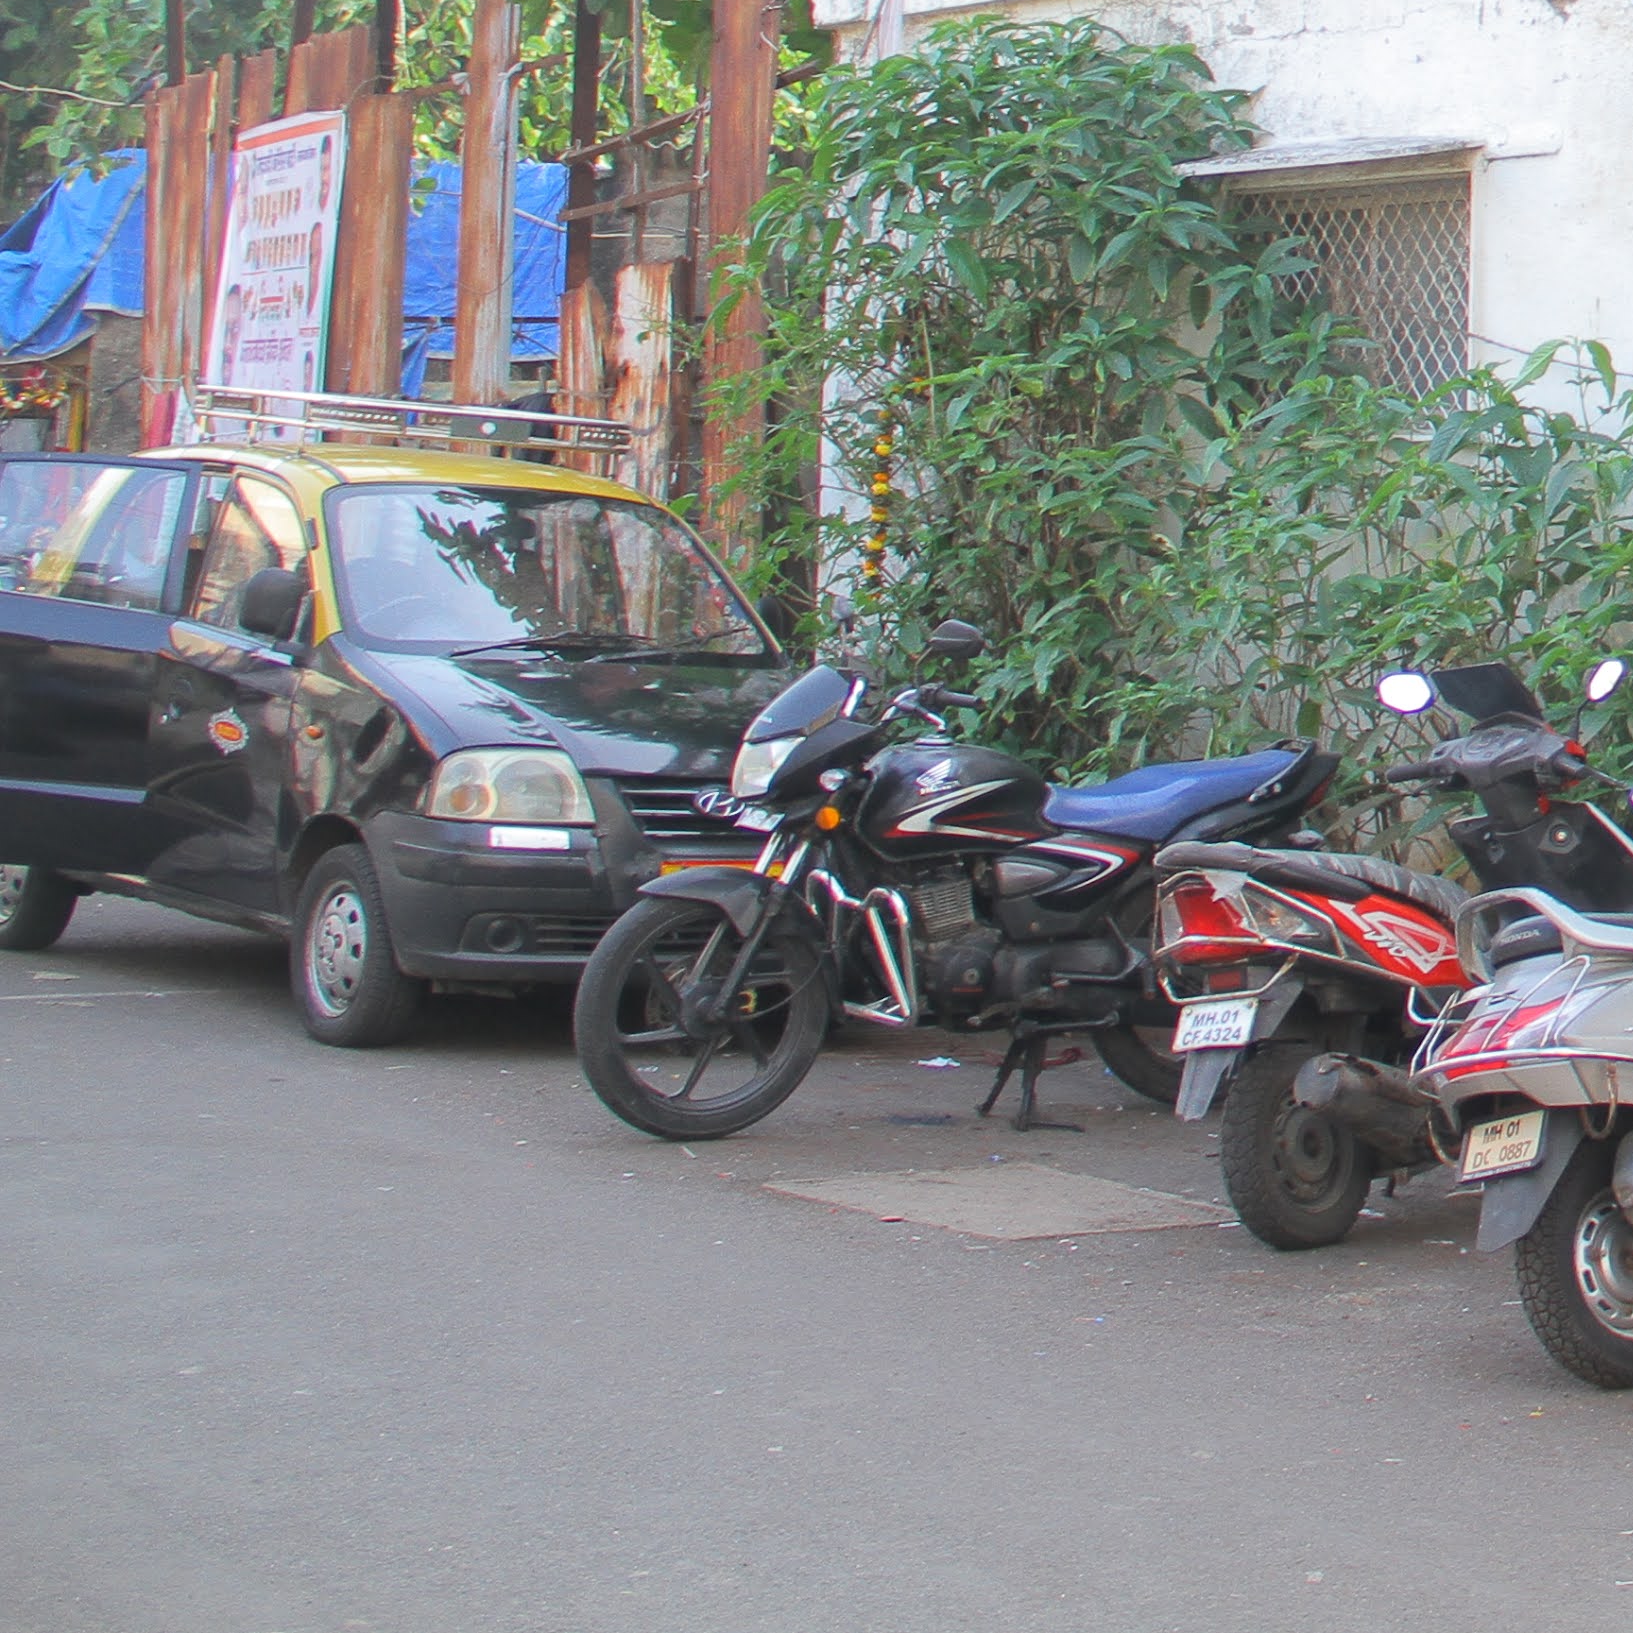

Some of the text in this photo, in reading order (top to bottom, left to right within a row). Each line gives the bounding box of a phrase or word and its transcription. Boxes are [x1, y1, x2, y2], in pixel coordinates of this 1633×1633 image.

[1191, 1009, 1240, 1027] MH.01
[1482, 1118, 1521, 1145] MH 01
[1472, 1140, 1532, 1169] DC 0887
